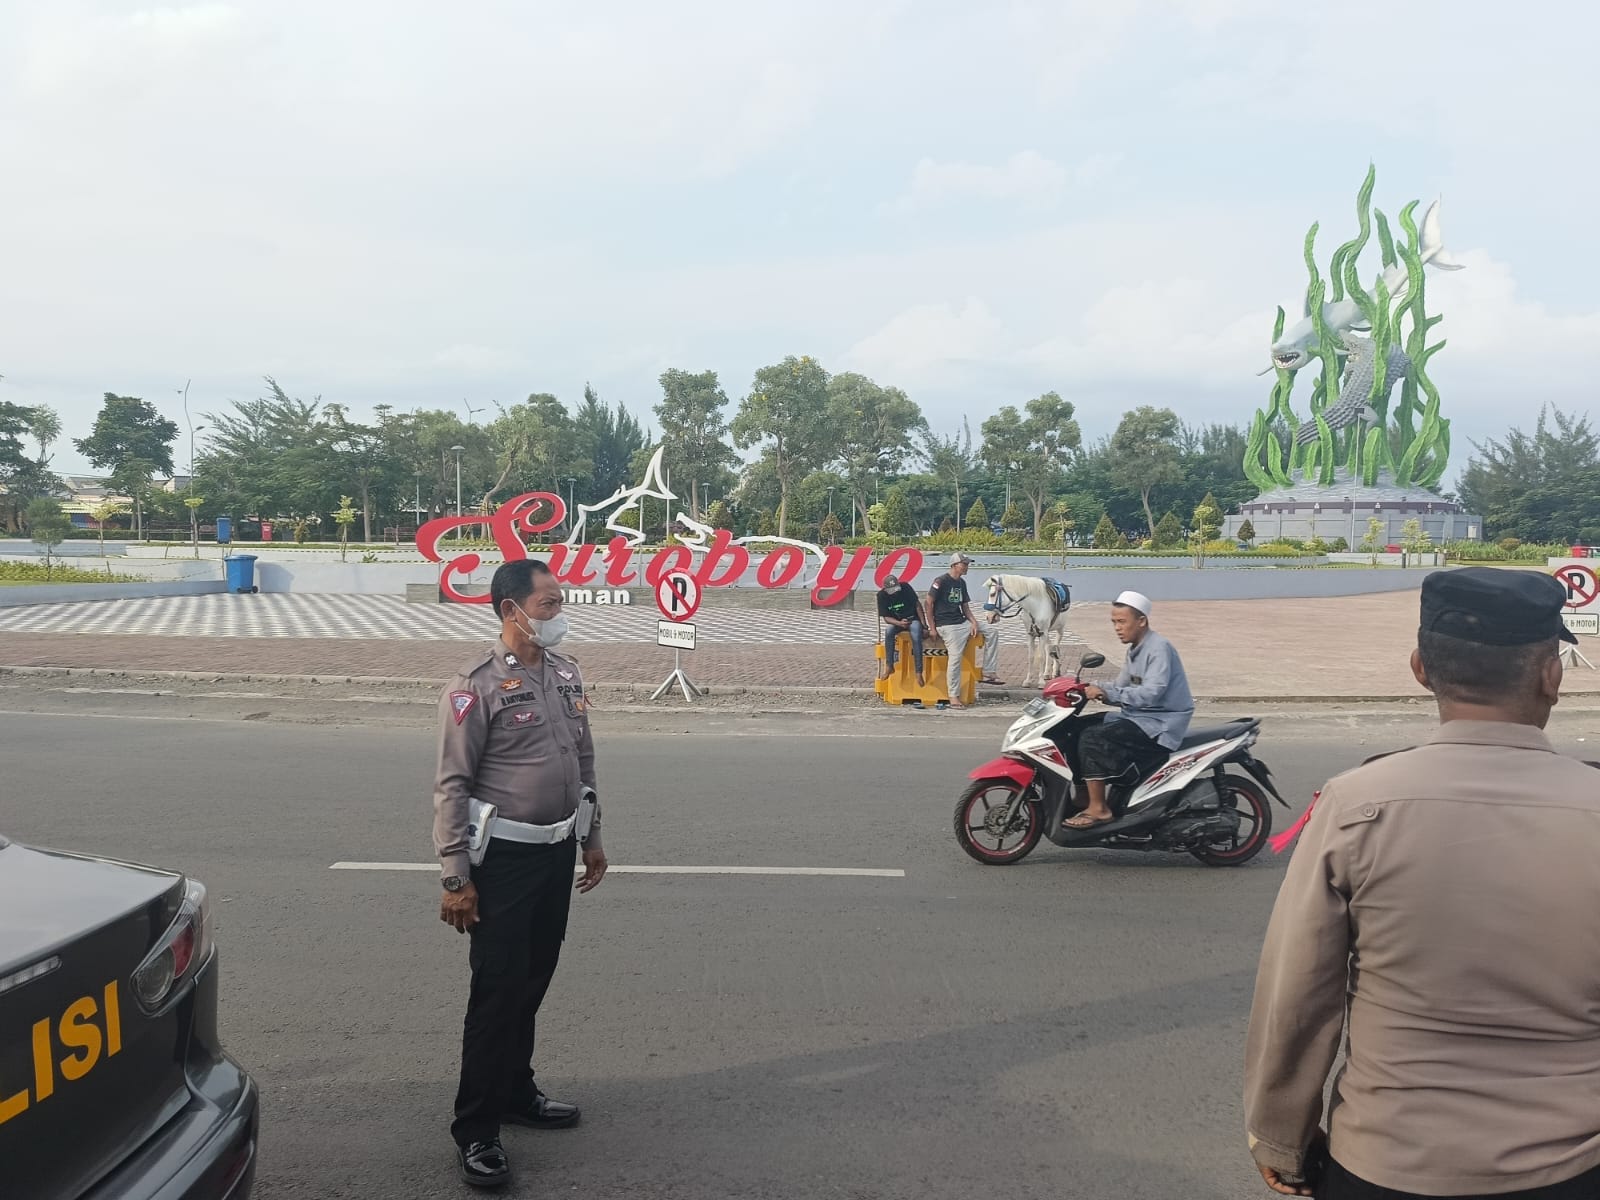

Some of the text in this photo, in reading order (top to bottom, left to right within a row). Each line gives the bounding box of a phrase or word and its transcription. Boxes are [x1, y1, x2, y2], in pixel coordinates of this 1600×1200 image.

[671, 576, 687, 612] P
[1567, 572, 1586, 600] P
[1576, 619, 1596, 628] MOTOR
[678, 630, 695, 641] MOTOR
